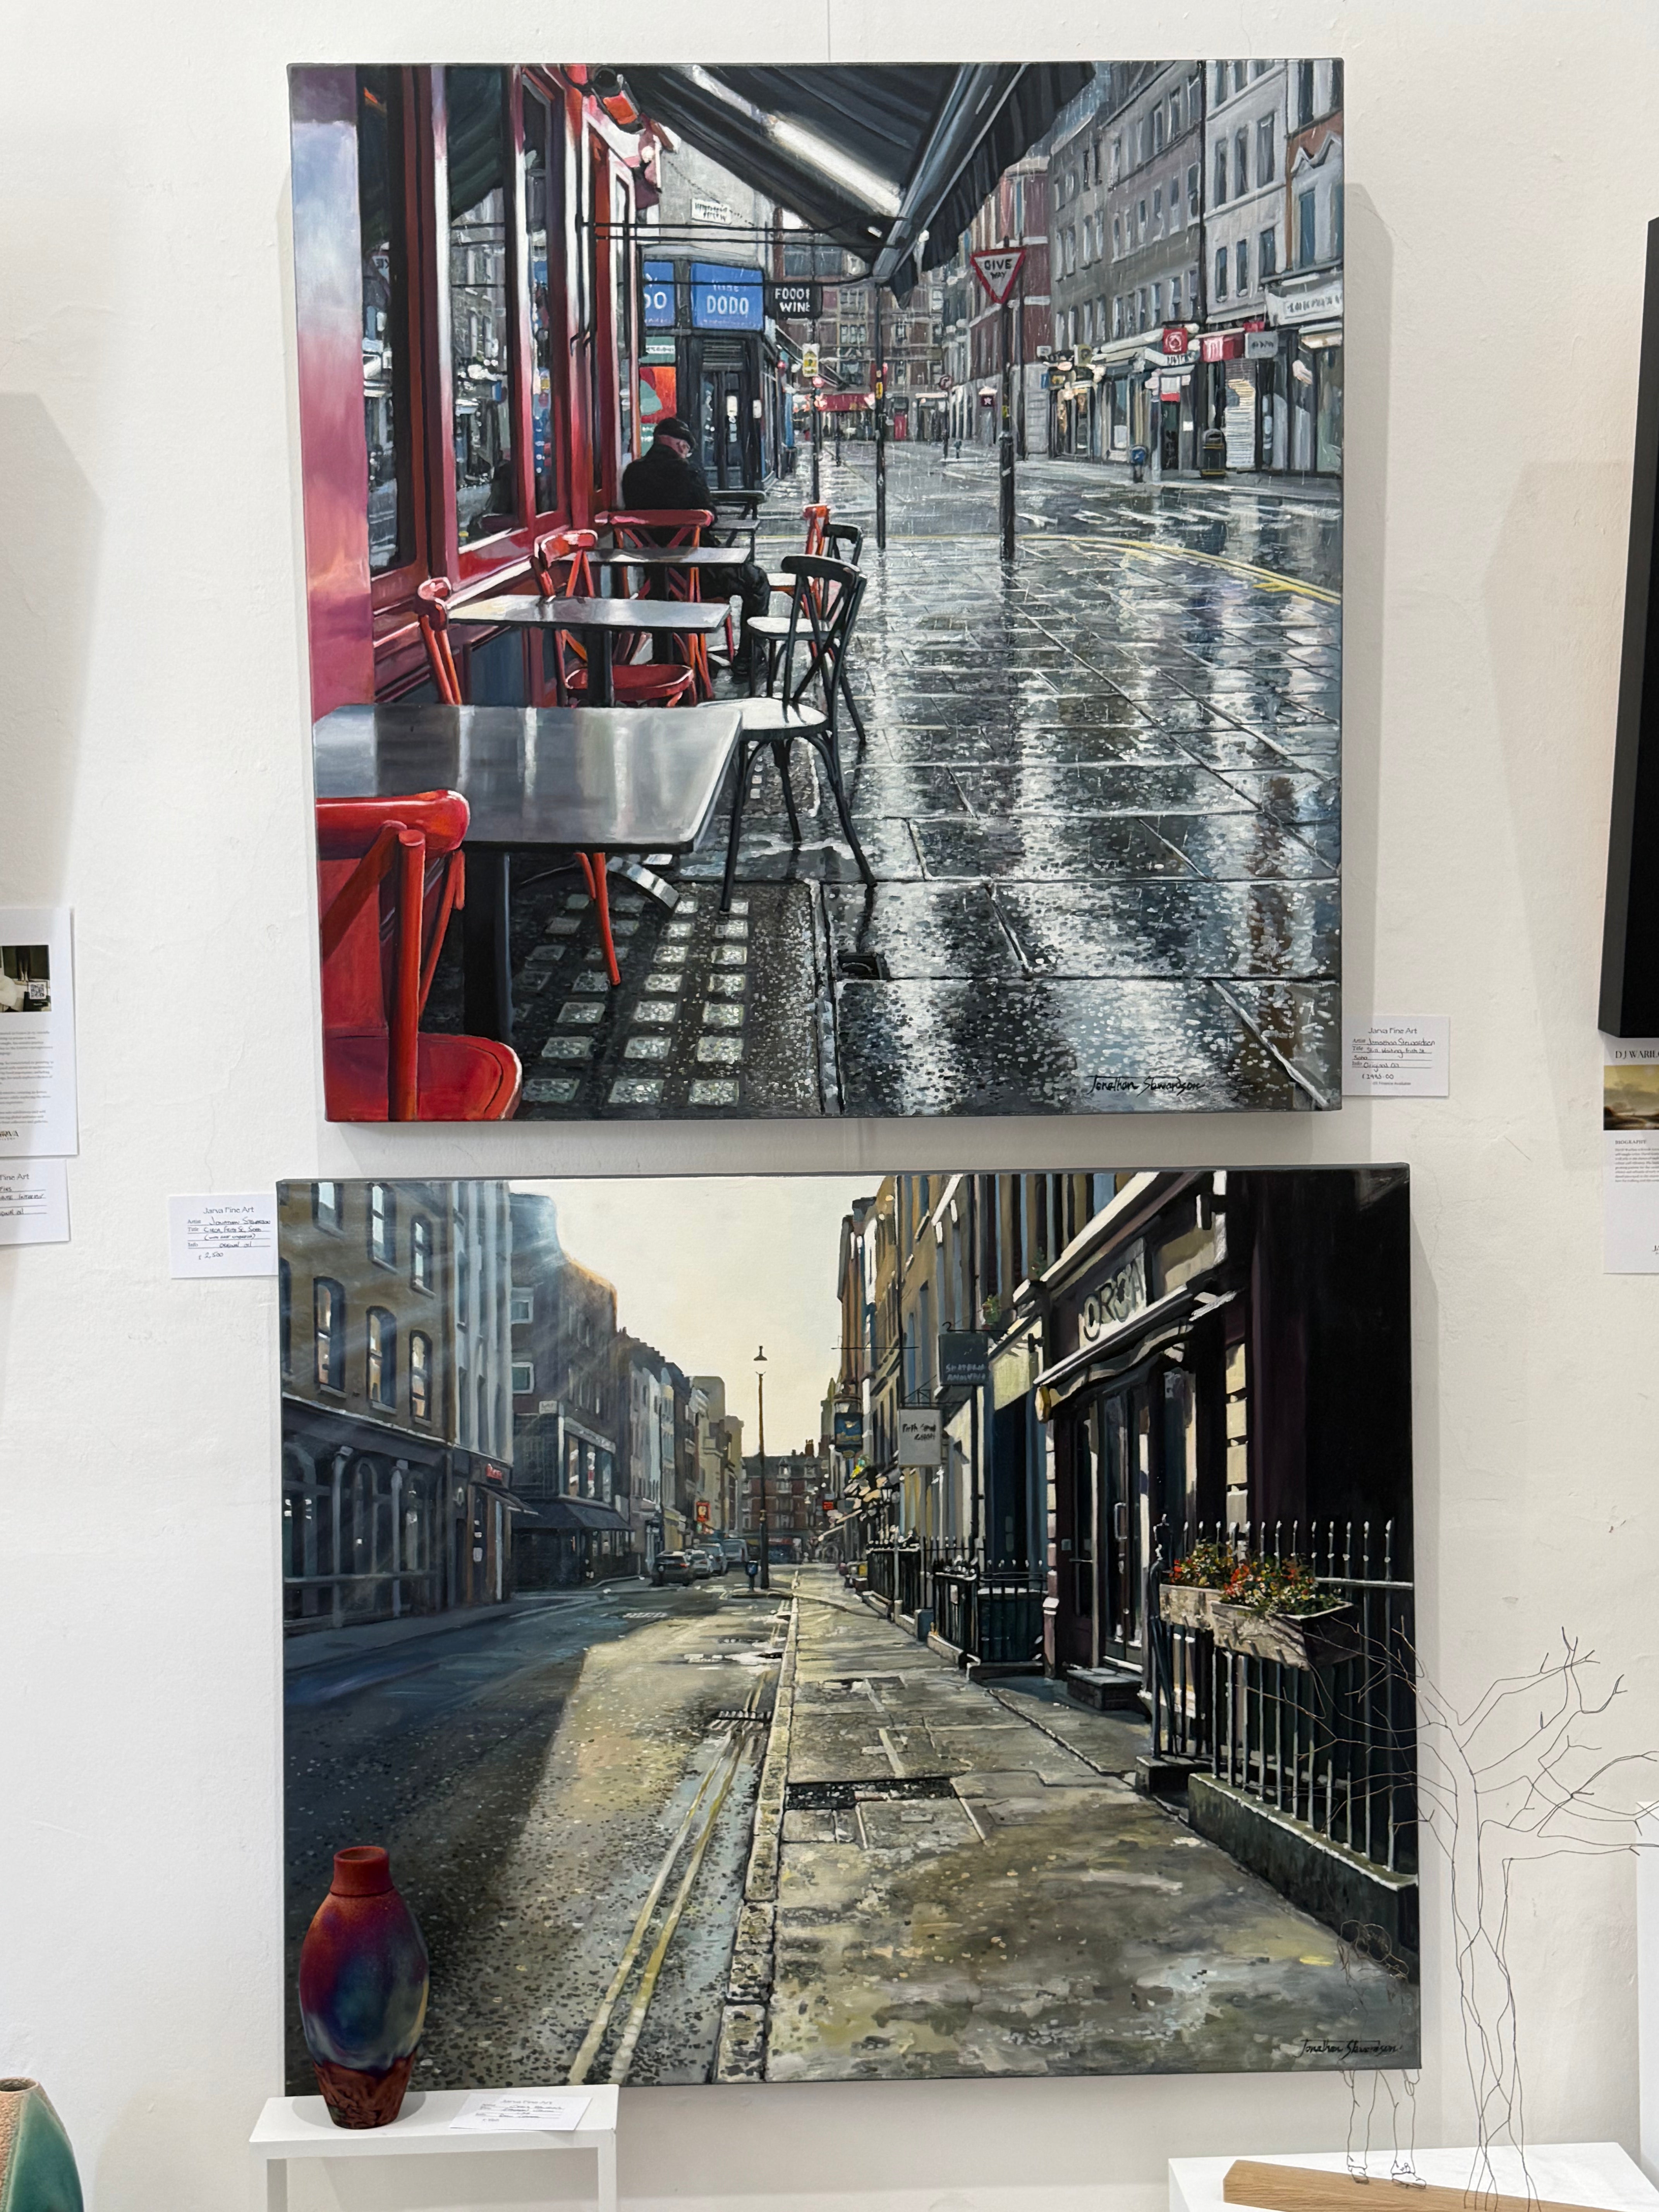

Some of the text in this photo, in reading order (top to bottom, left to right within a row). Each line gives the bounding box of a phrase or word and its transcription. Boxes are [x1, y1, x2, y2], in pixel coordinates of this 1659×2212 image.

[984, 259, 1012, 270] GIVE
[707, 295, 749, 315] DODO
[779, 302, 810, 312] WINE
